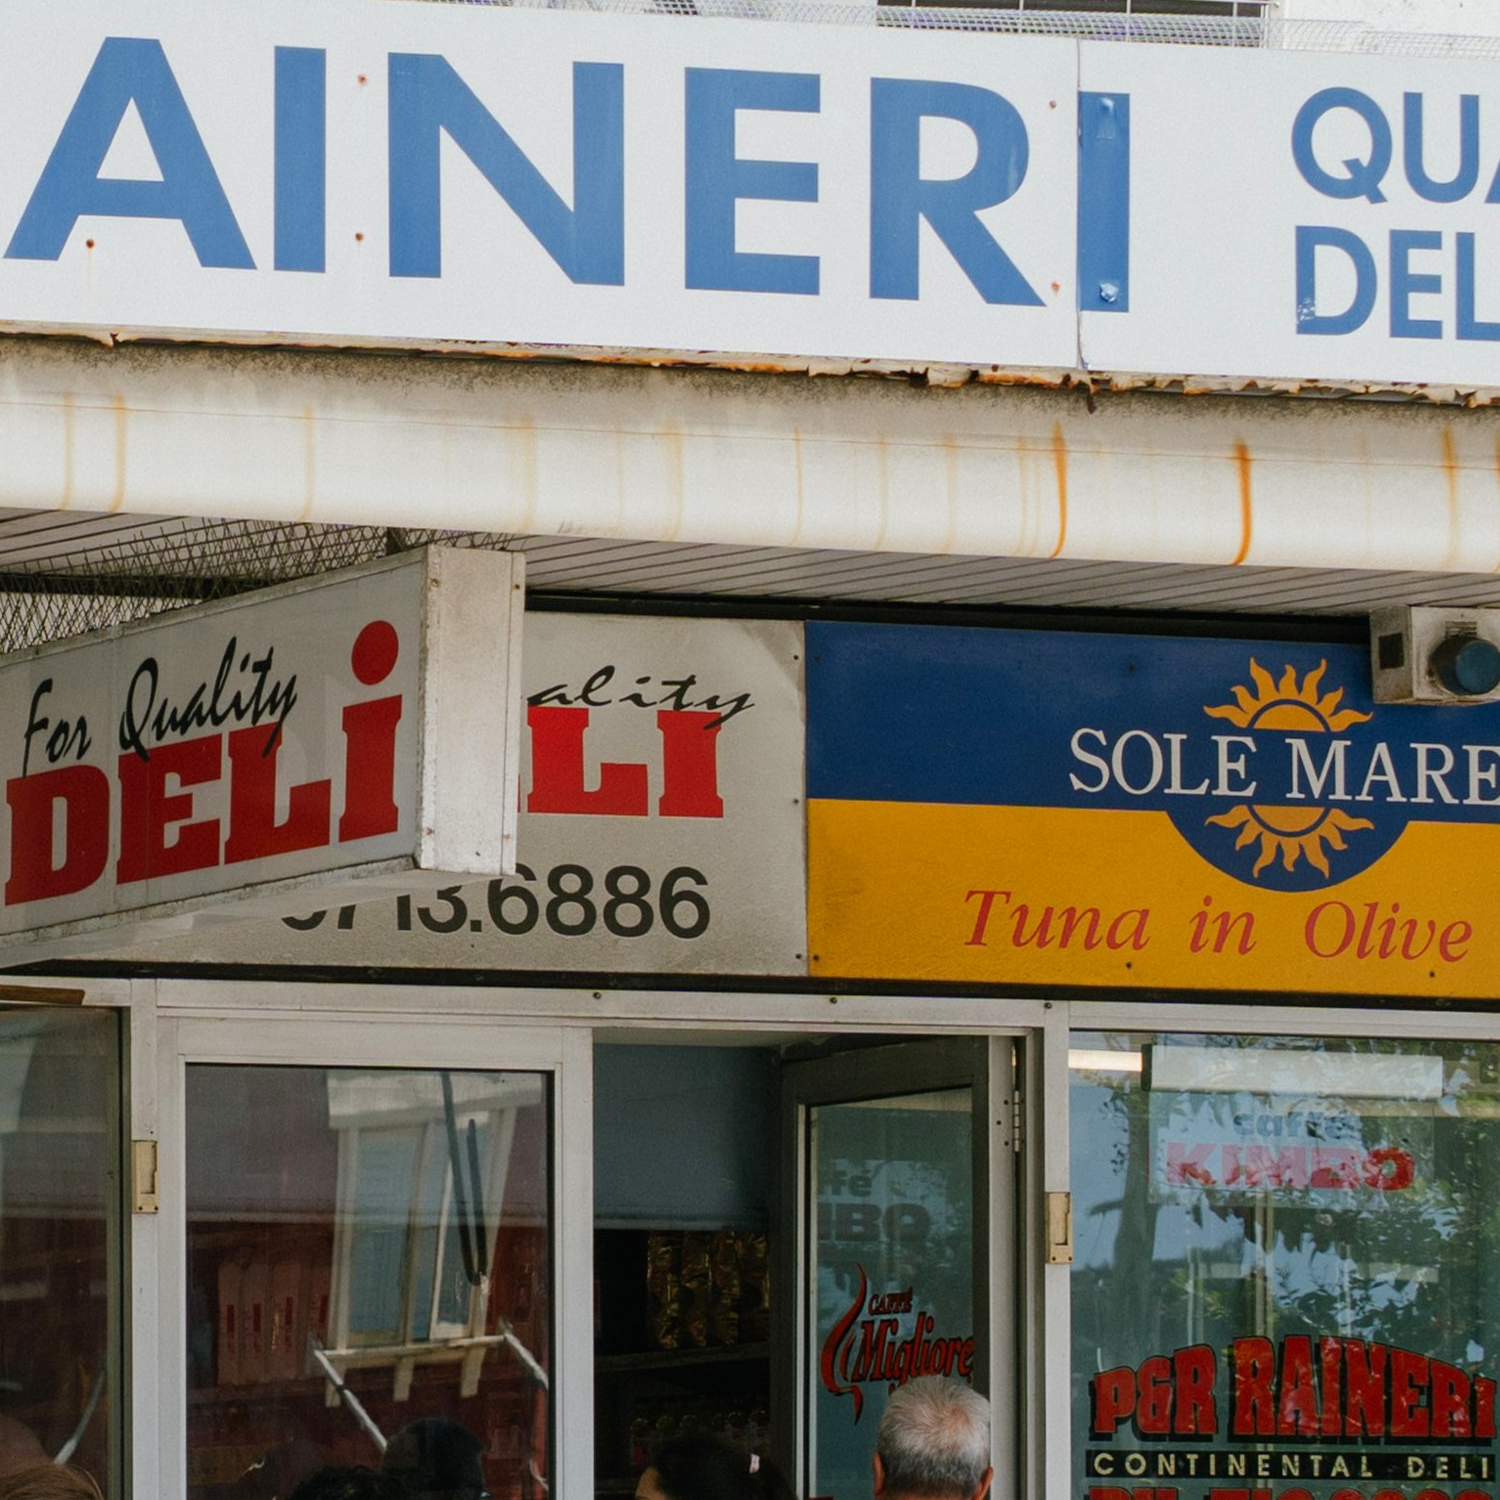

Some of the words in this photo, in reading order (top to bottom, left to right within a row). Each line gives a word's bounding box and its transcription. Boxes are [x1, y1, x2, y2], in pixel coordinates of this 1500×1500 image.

[22, 678, 92, 778] For
[118, 635, 297, 762] Quality
[1069, 727, 1257, 797] SOLE
[964, 889, 1151, 953] Tuna
[1190, 895, 1257, 956] in
[1304, 898, 1473, 966] Olive
[1166, 1141, 1415, 1192] KIMBO
[1228, 1333, 1498, 1443] RAINERI
[1093, 1450, 1374, 1480] CONTINENTAL
[1405, 1452, 1490, 1480] DELI
